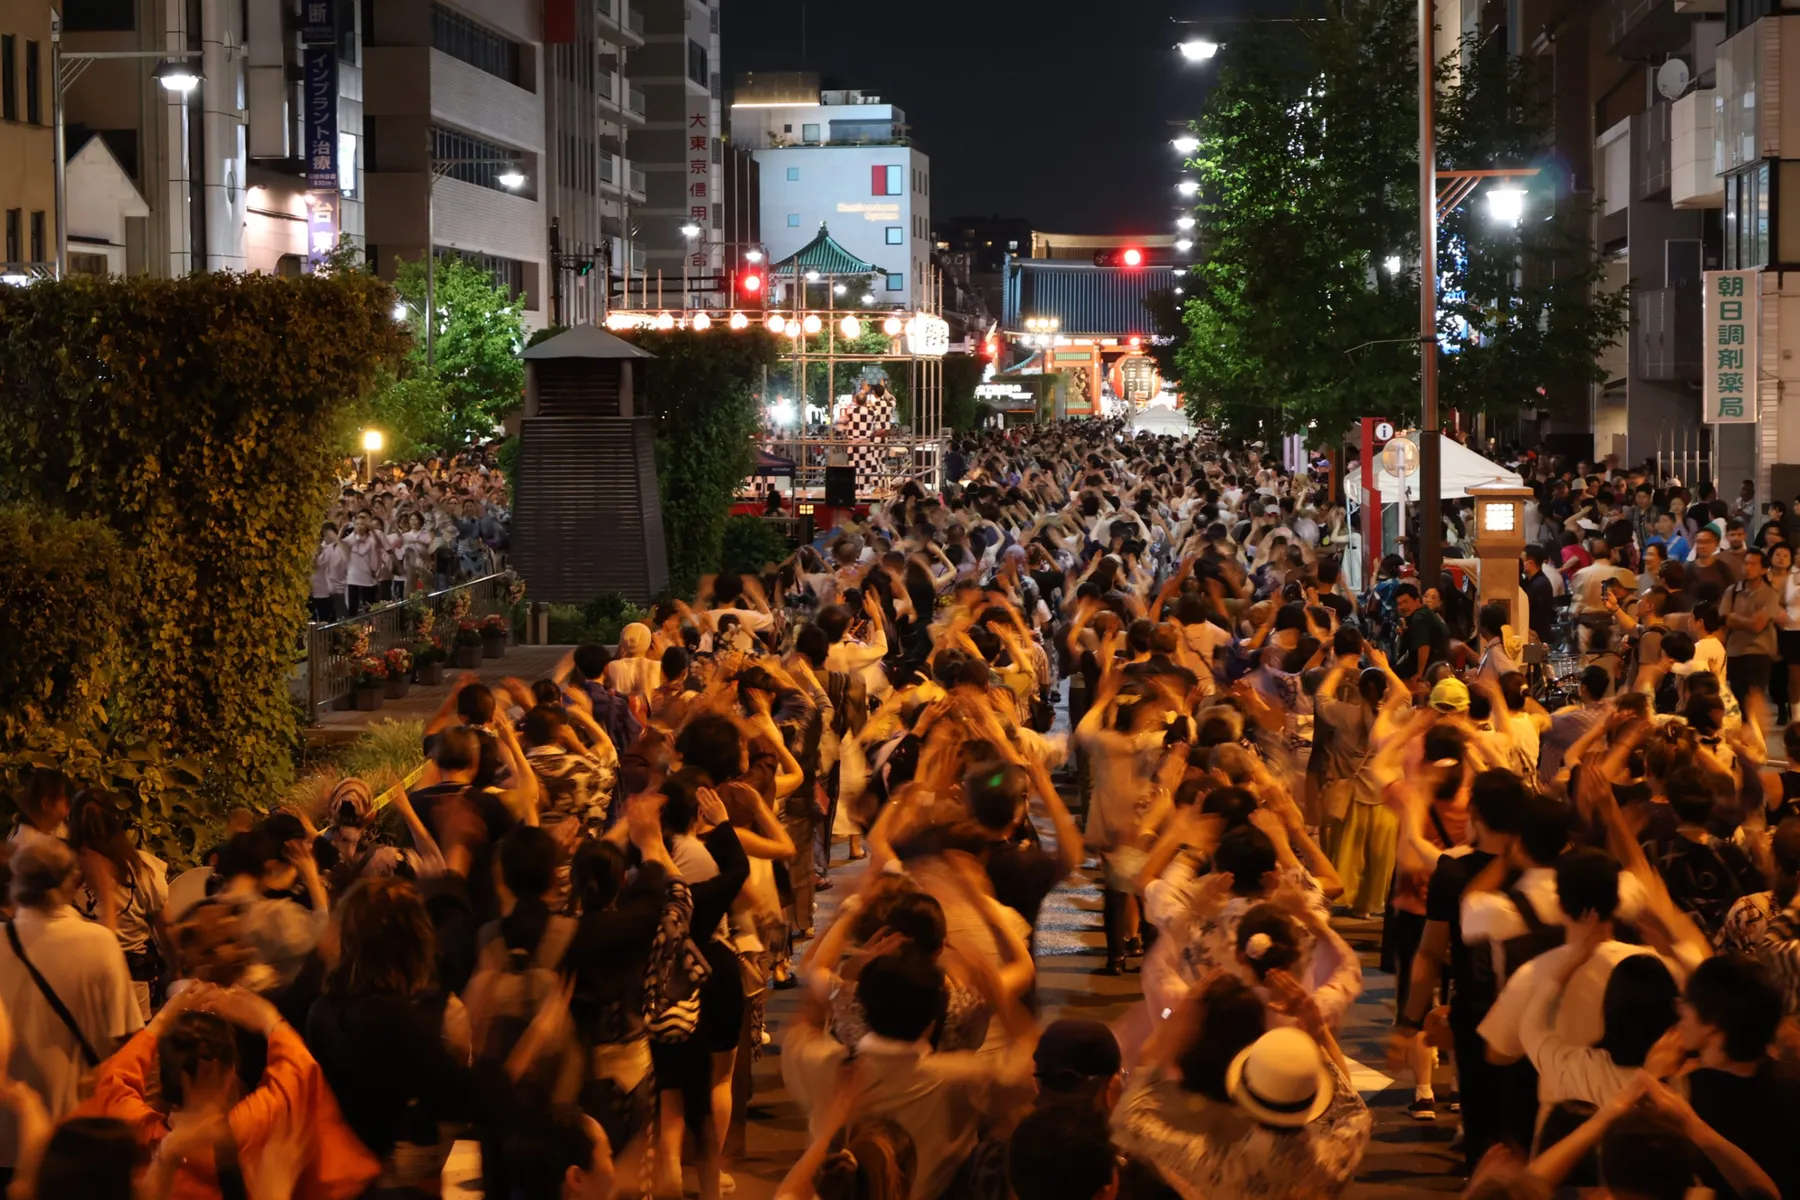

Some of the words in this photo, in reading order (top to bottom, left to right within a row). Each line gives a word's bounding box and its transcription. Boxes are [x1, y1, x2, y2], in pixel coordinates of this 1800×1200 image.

[312, 54, 331, 169] インプラント治療
[689, 113, 707, 267] 大東京信用合
[1717, 276, 1744, 418] 朝日調剤薬局
